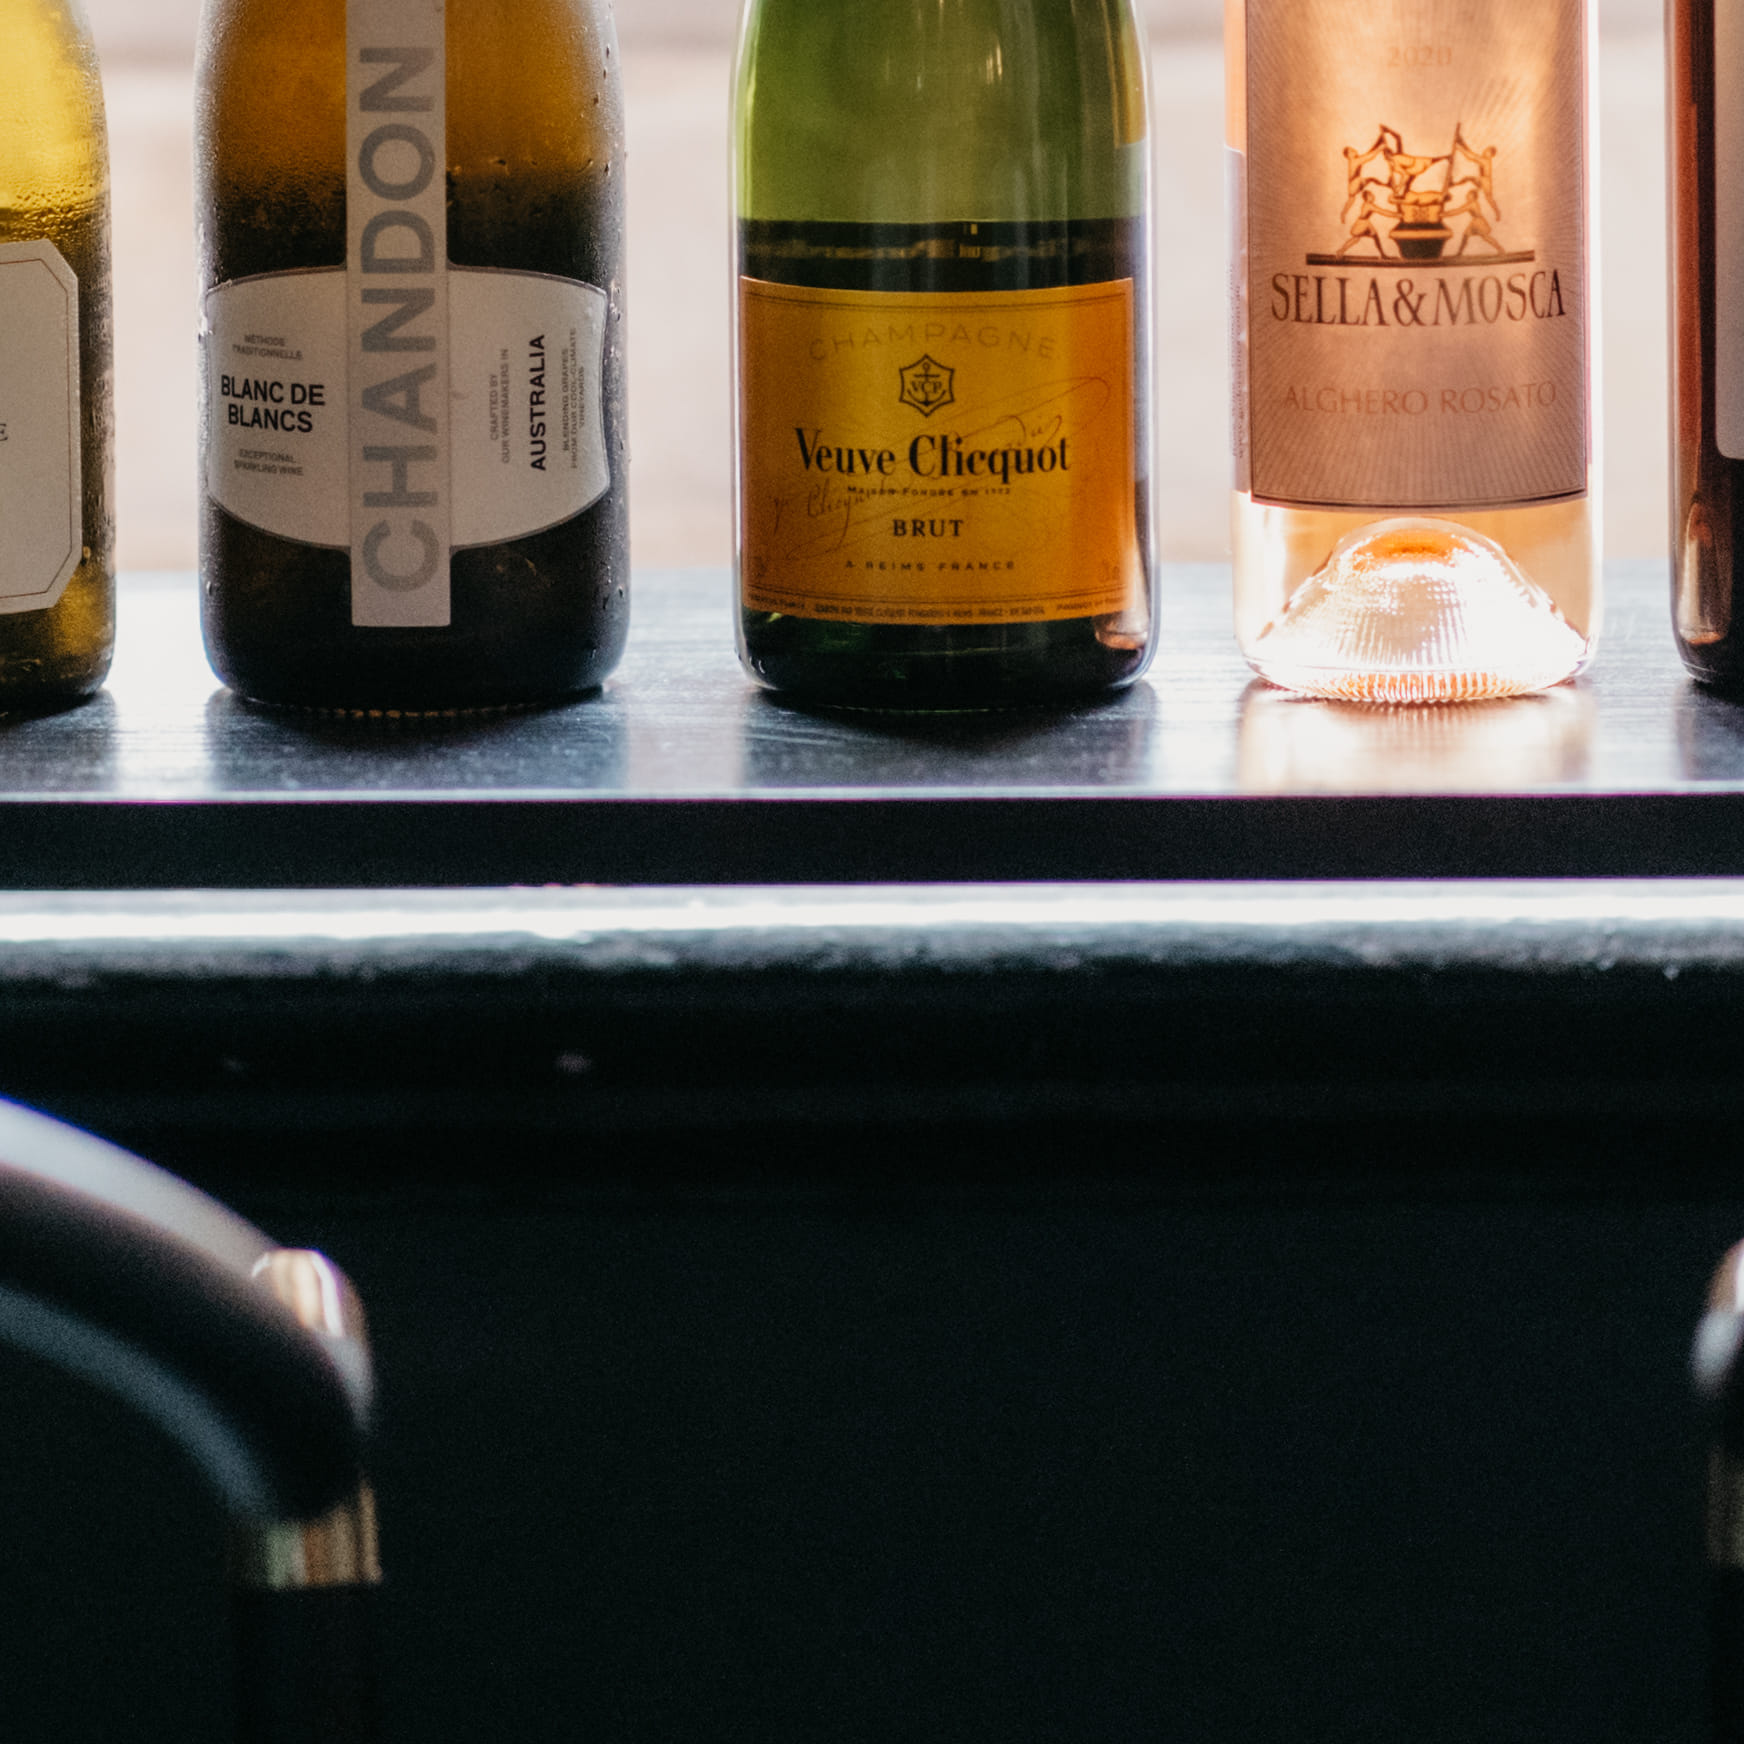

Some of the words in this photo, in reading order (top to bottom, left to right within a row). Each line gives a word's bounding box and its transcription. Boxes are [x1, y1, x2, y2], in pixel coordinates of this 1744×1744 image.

[358, 47, 441, 594] CHANDON
[500, 348, 509, 364] IN
[809, 324, 1056, 361] CHAMPAGNE
[221, 375, 284, 404] BLANC
[291, 383, 325, 406] DE
[529, 335, 546, 470] AUSTRALIA
[1284, 386, 1429, 416] ALGHERO
[1441, 381, 1557, 413] ROSATO
[228, 404, 313, 433] BLANCS
[794, 428, 896, 476] Veuve
[909, 435, 1071, 484] Clicquot
[893, 520, 964, 537] BRUT
